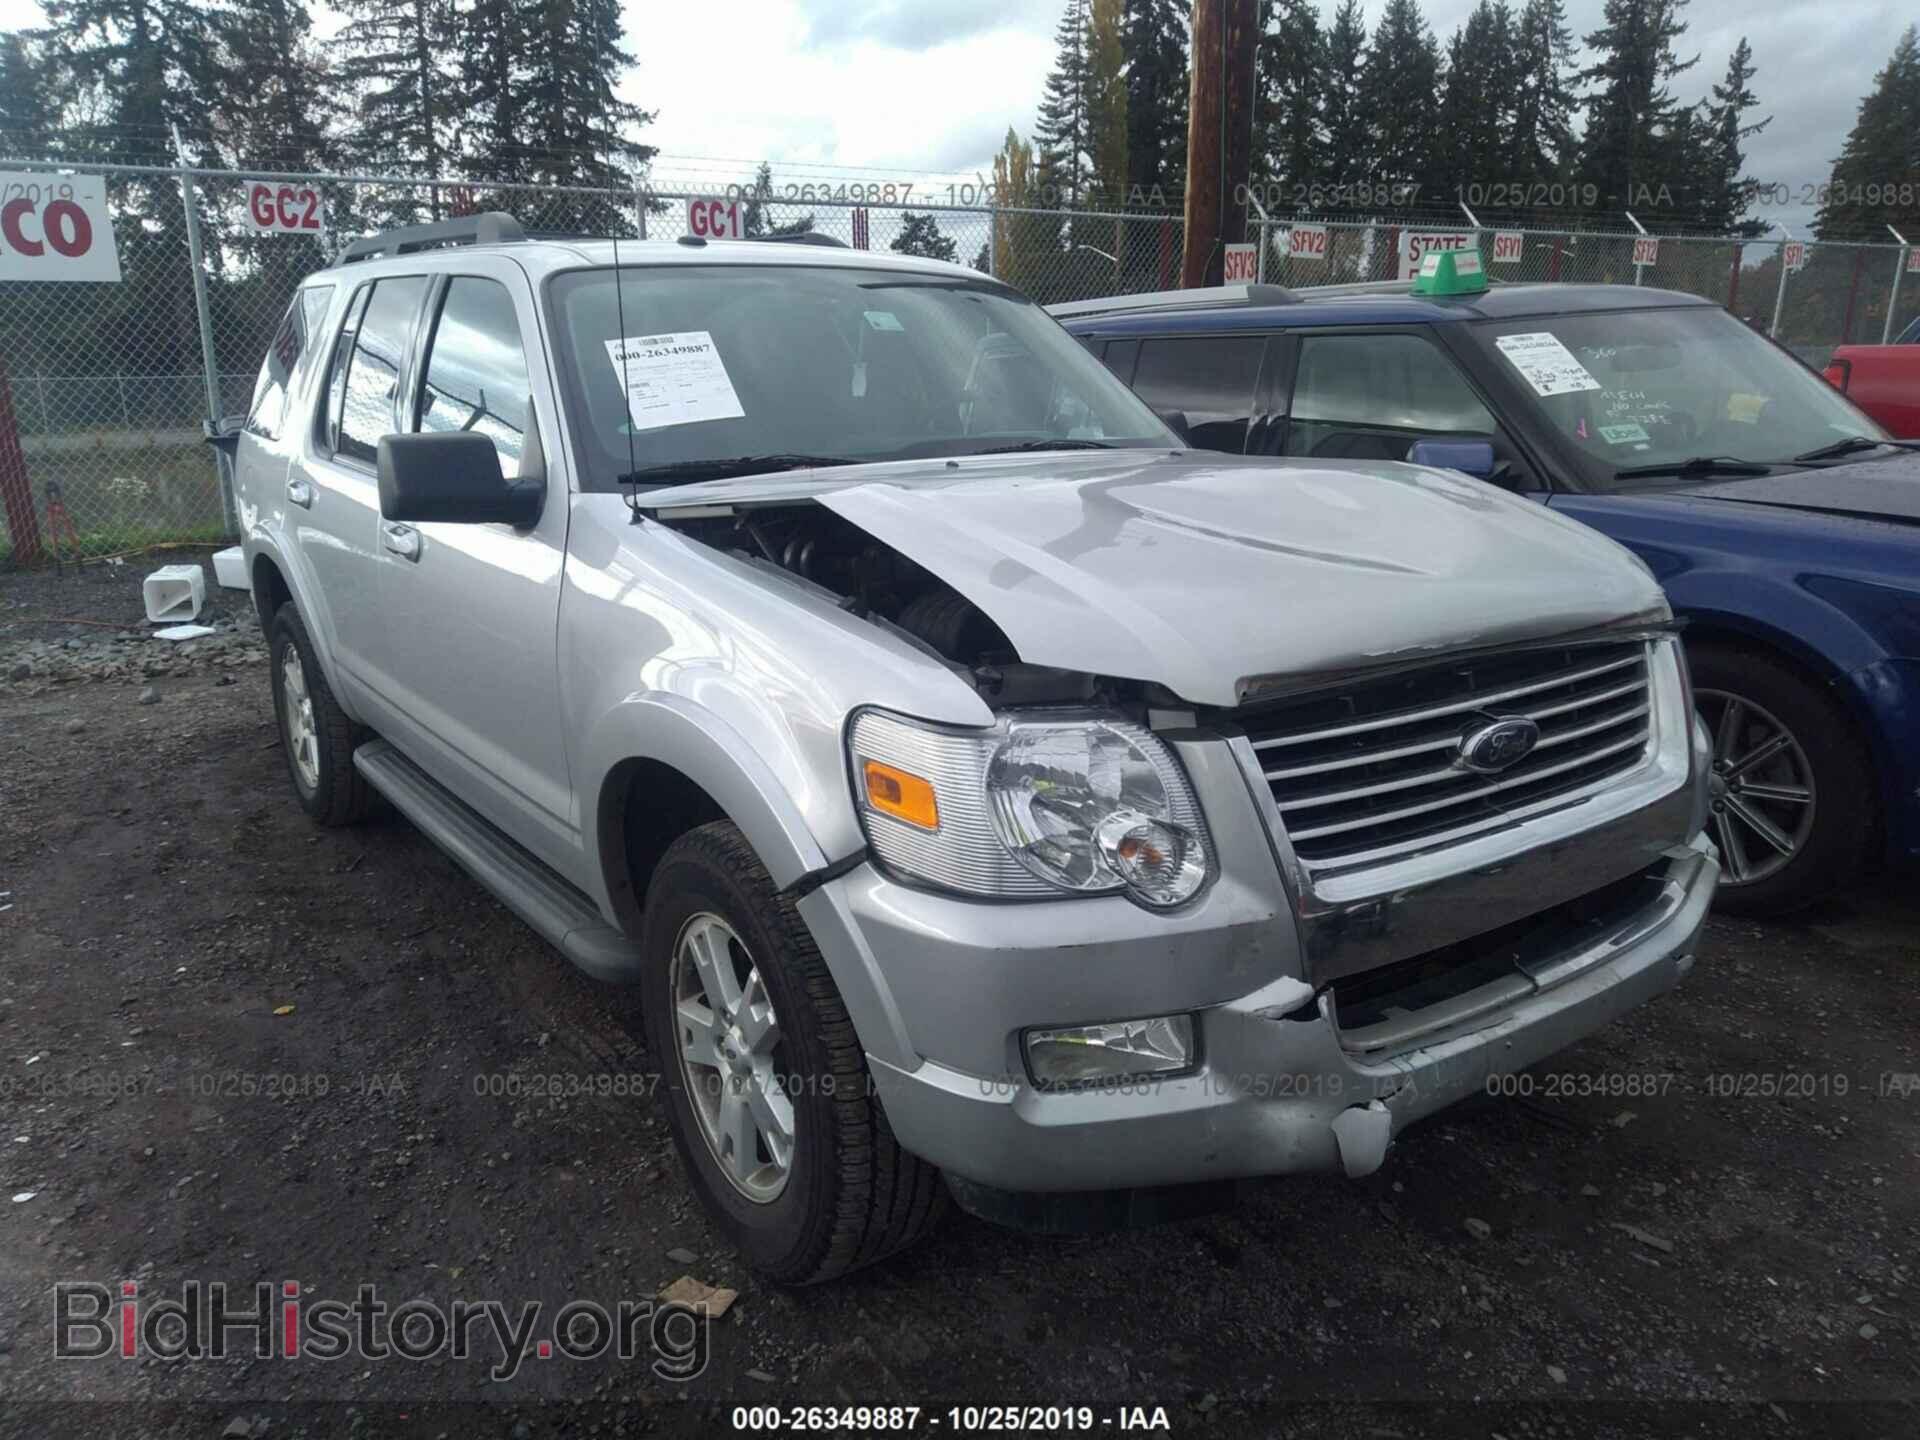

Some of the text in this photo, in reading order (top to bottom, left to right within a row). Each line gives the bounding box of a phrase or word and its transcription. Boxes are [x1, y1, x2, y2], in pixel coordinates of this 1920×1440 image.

[251, 184, 320, 229] GC2
[690, 202, 740, 238] GC1
[0, 198, 92, 258] CO
[1292, 226, 1326, 253] SFV2
[1225, 250, 1255, 281] SFV3
